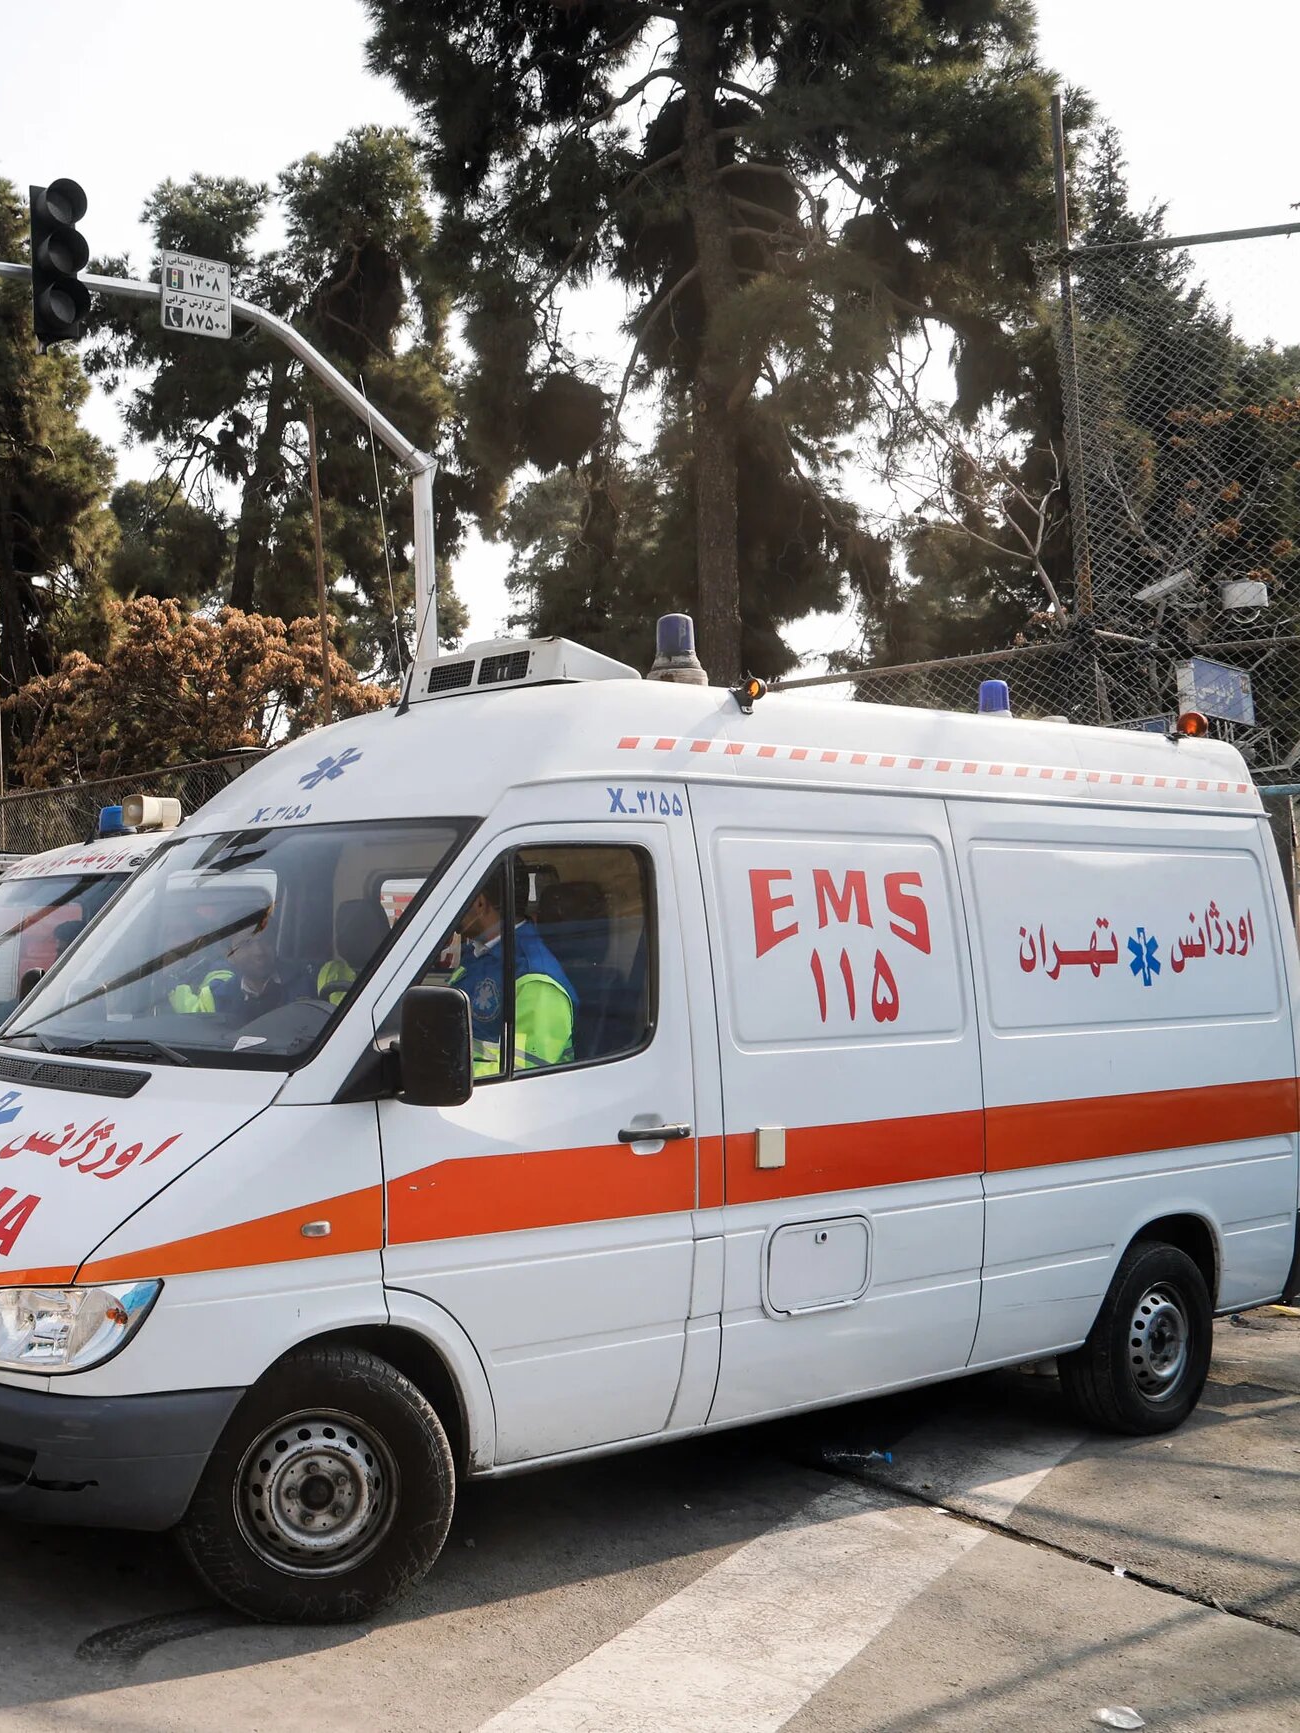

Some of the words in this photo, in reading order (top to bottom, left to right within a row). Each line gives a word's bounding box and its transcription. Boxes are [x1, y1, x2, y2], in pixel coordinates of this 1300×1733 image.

[189, 272, 220, 292] ۱۳۰۸
[185, 312, 227, 331] ۸۷۵۰۰
[748, 869, 931, 959] EMS
[1018, 916, 1119, 981] تهران
[1170, 900, 1255, 974] اورژانس
[809, 947, 900, 1023] ۱۱۵
